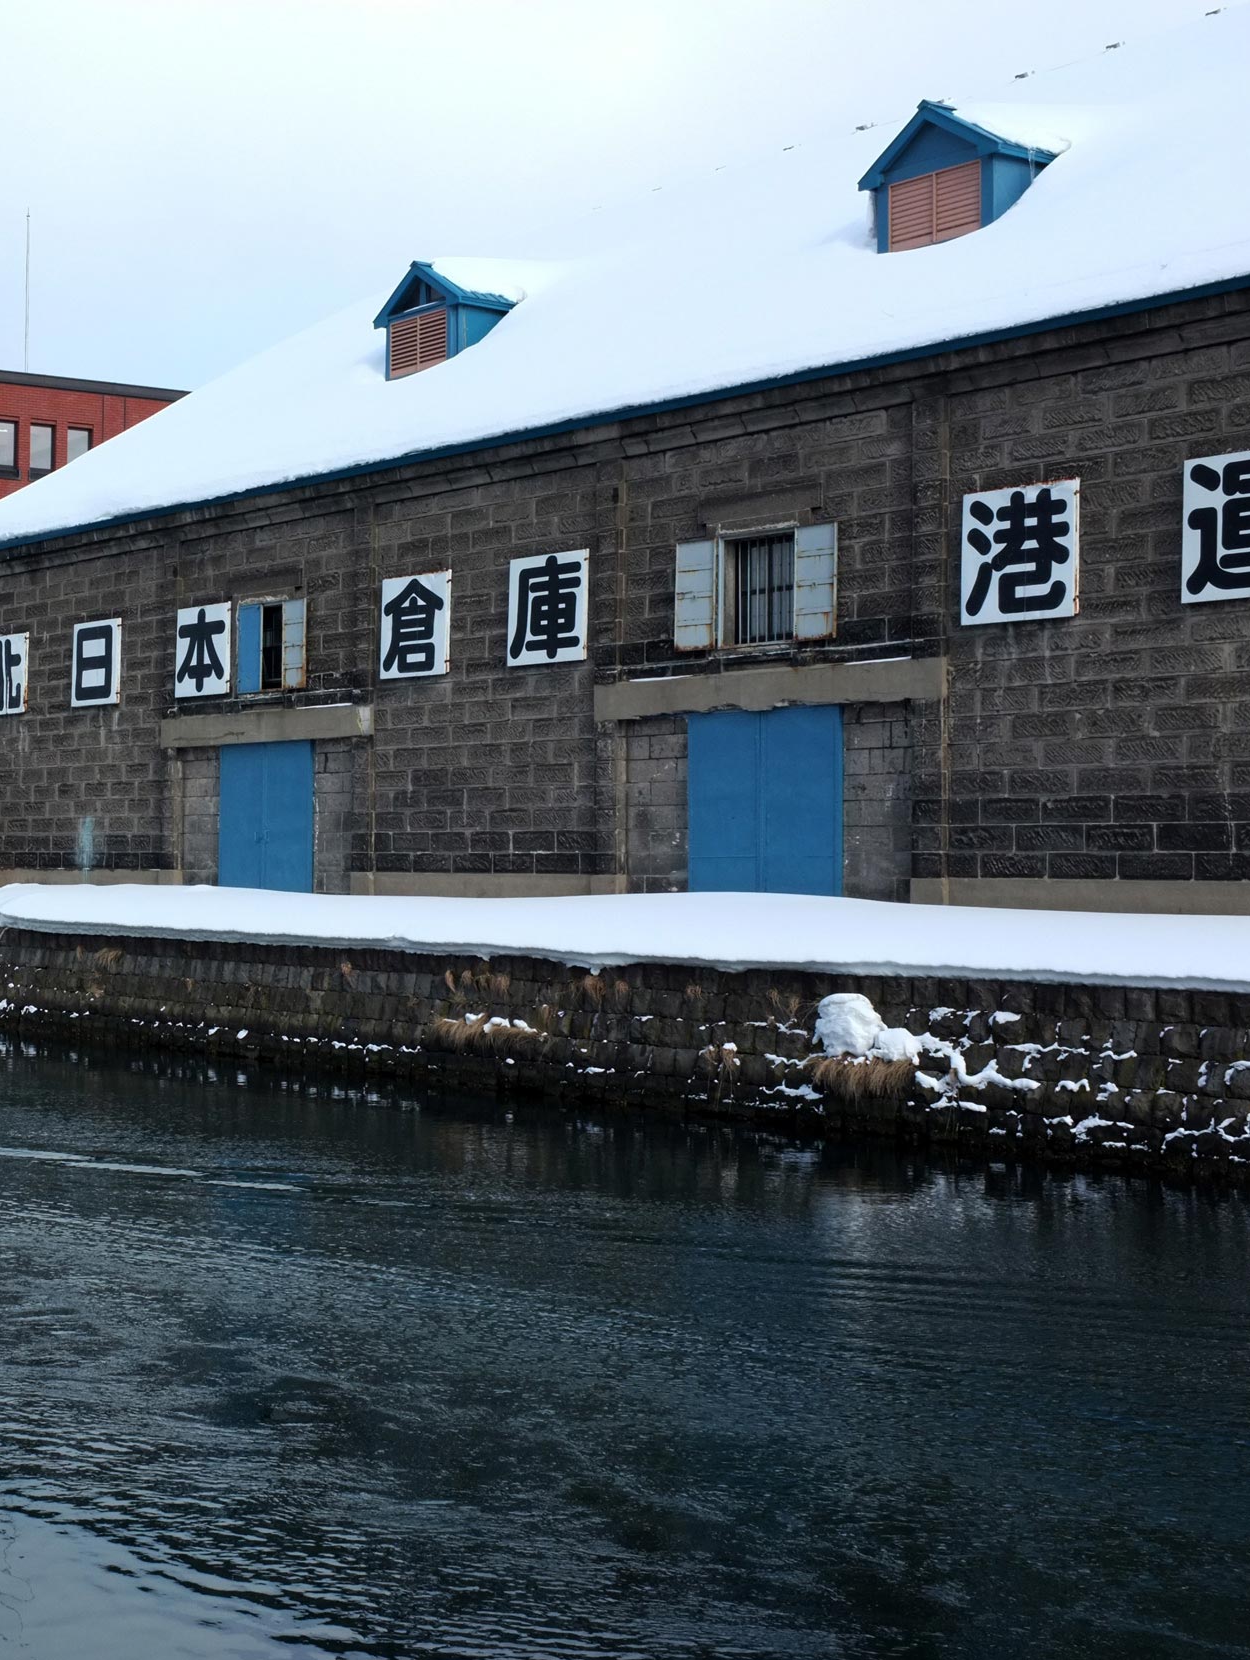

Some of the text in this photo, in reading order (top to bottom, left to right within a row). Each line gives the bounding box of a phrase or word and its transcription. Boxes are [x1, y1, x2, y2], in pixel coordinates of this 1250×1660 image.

[75, 624, 113, 701] 日
[176, 607, 226, 693] 本
[382, 577, 444, 674] 倉
[510, 555, 582, 660] 庫
[965, 487, 1070, 617] 港
